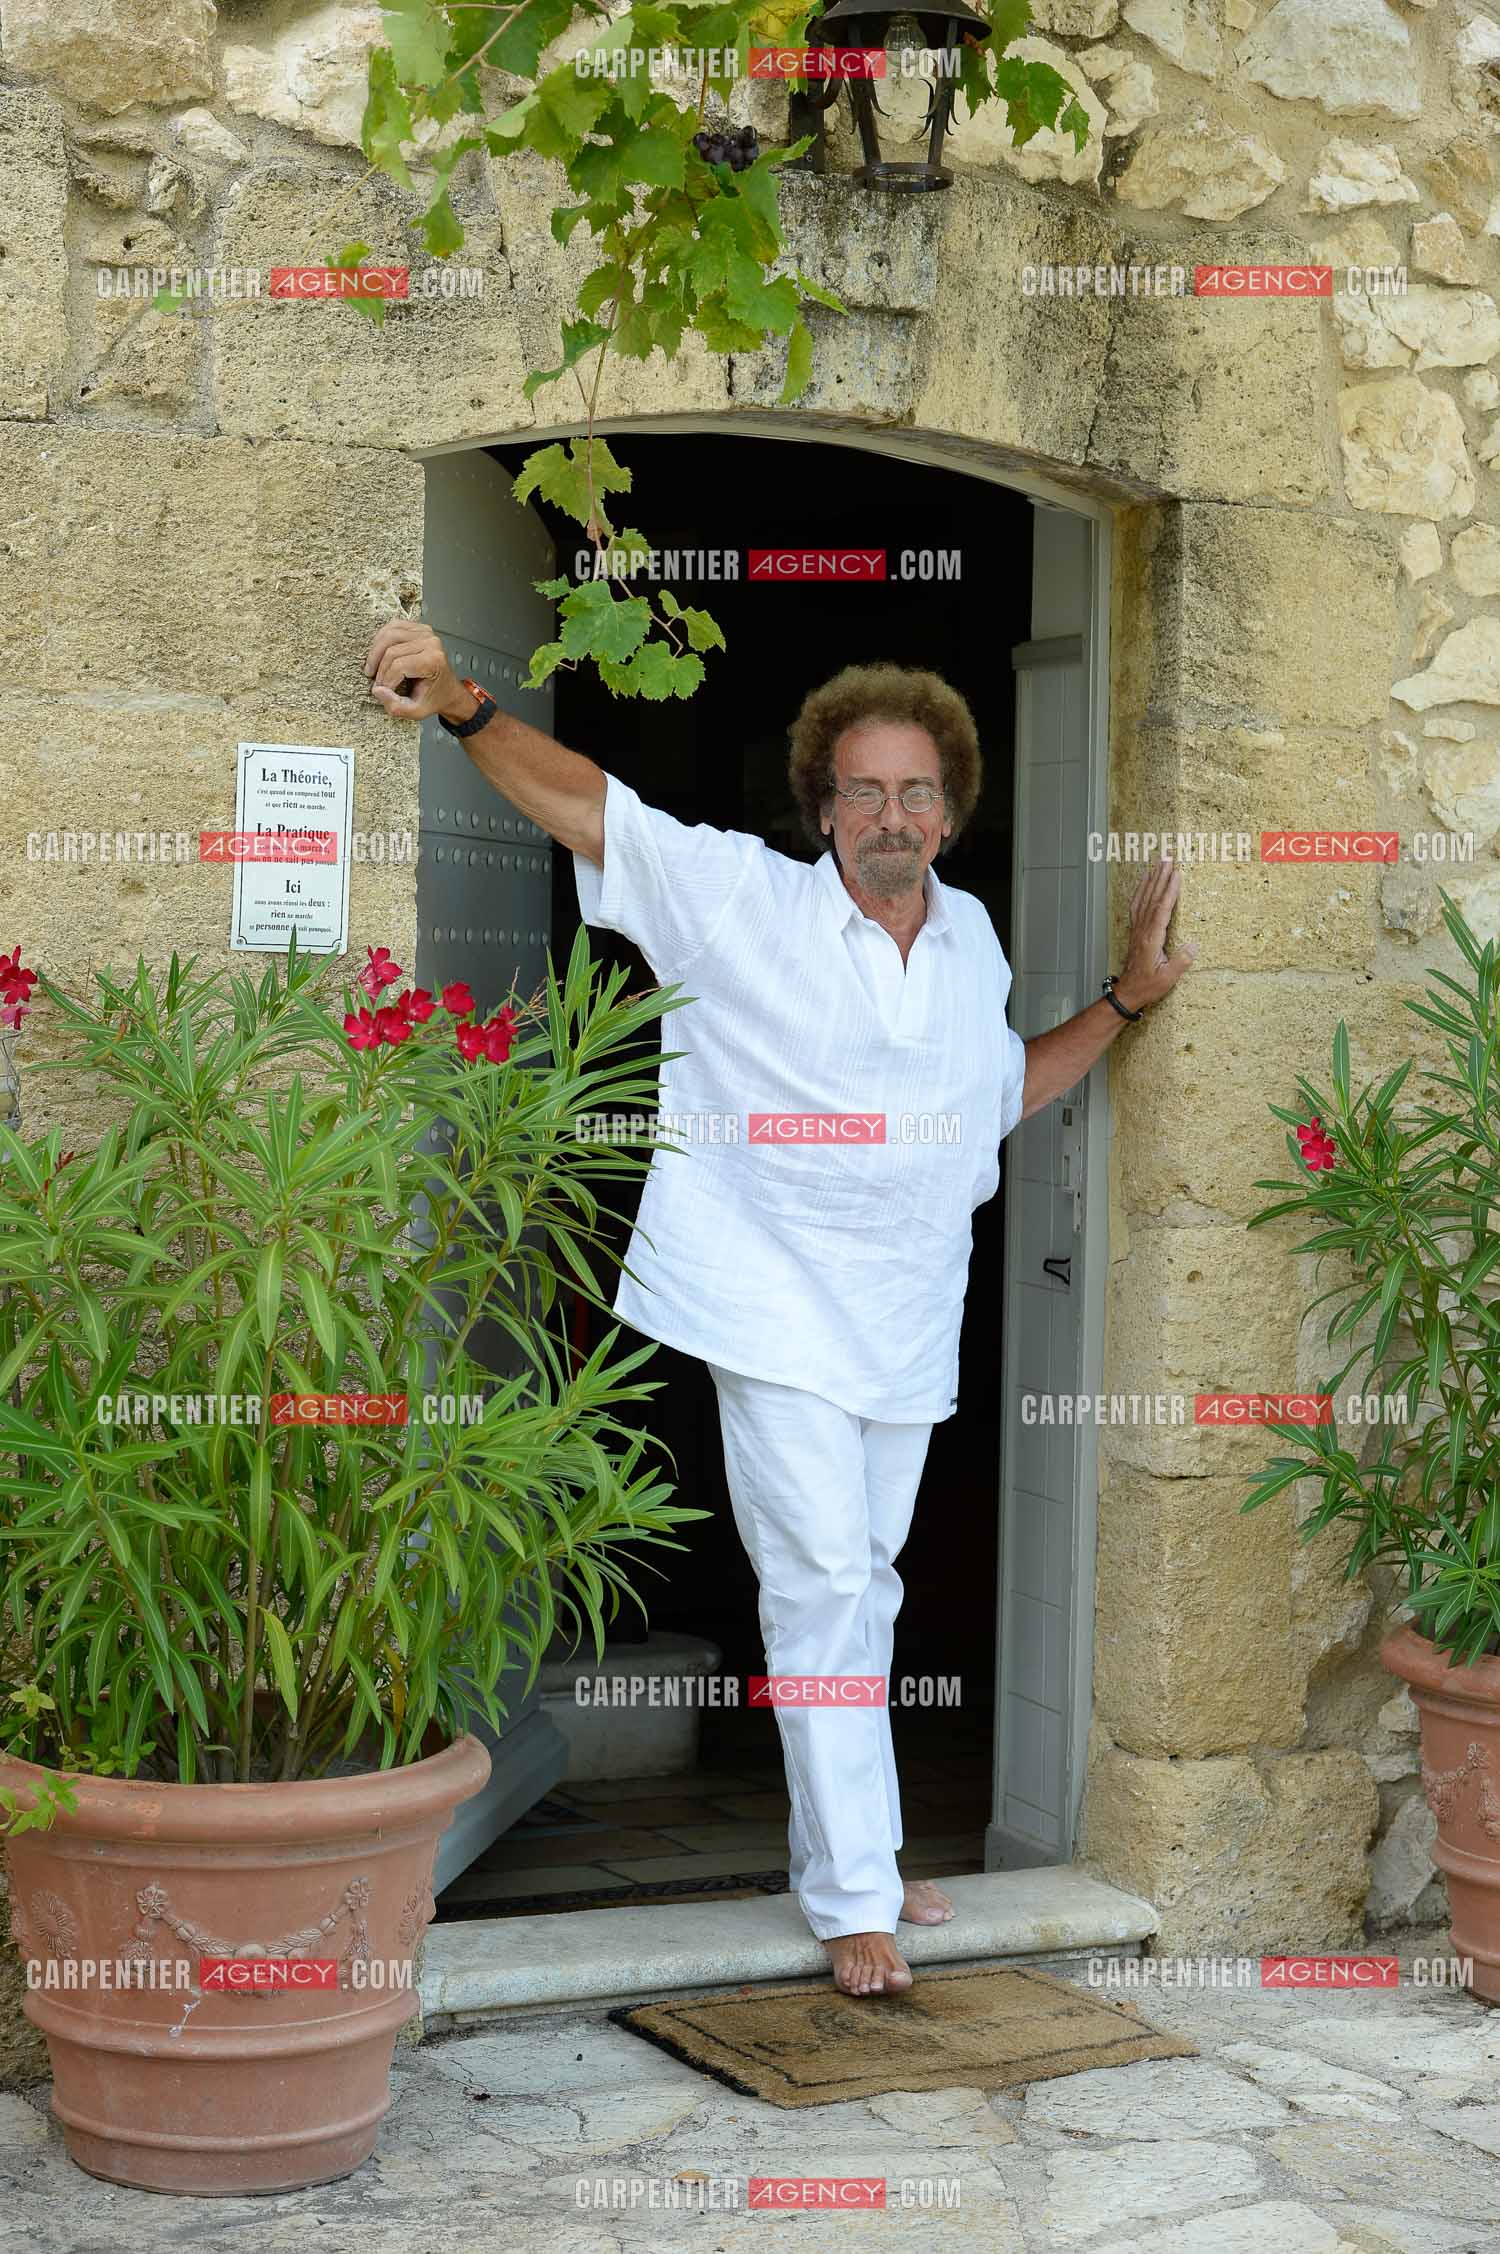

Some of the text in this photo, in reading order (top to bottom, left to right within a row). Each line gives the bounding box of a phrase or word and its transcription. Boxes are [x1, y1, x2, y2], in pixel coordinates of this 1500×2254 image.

[261, 768, 332, 788] La Théorie,
[321, 790, 335, 798] tout
[282, 800, 298, 809] rien
[256, 823, 330, 842] La Pratique
[286, 880, 301, 893] Ici
[308, 898, 325, 907] deux
[271, 909, 286, 918] rien
[255, 923, 290, 932] personne
